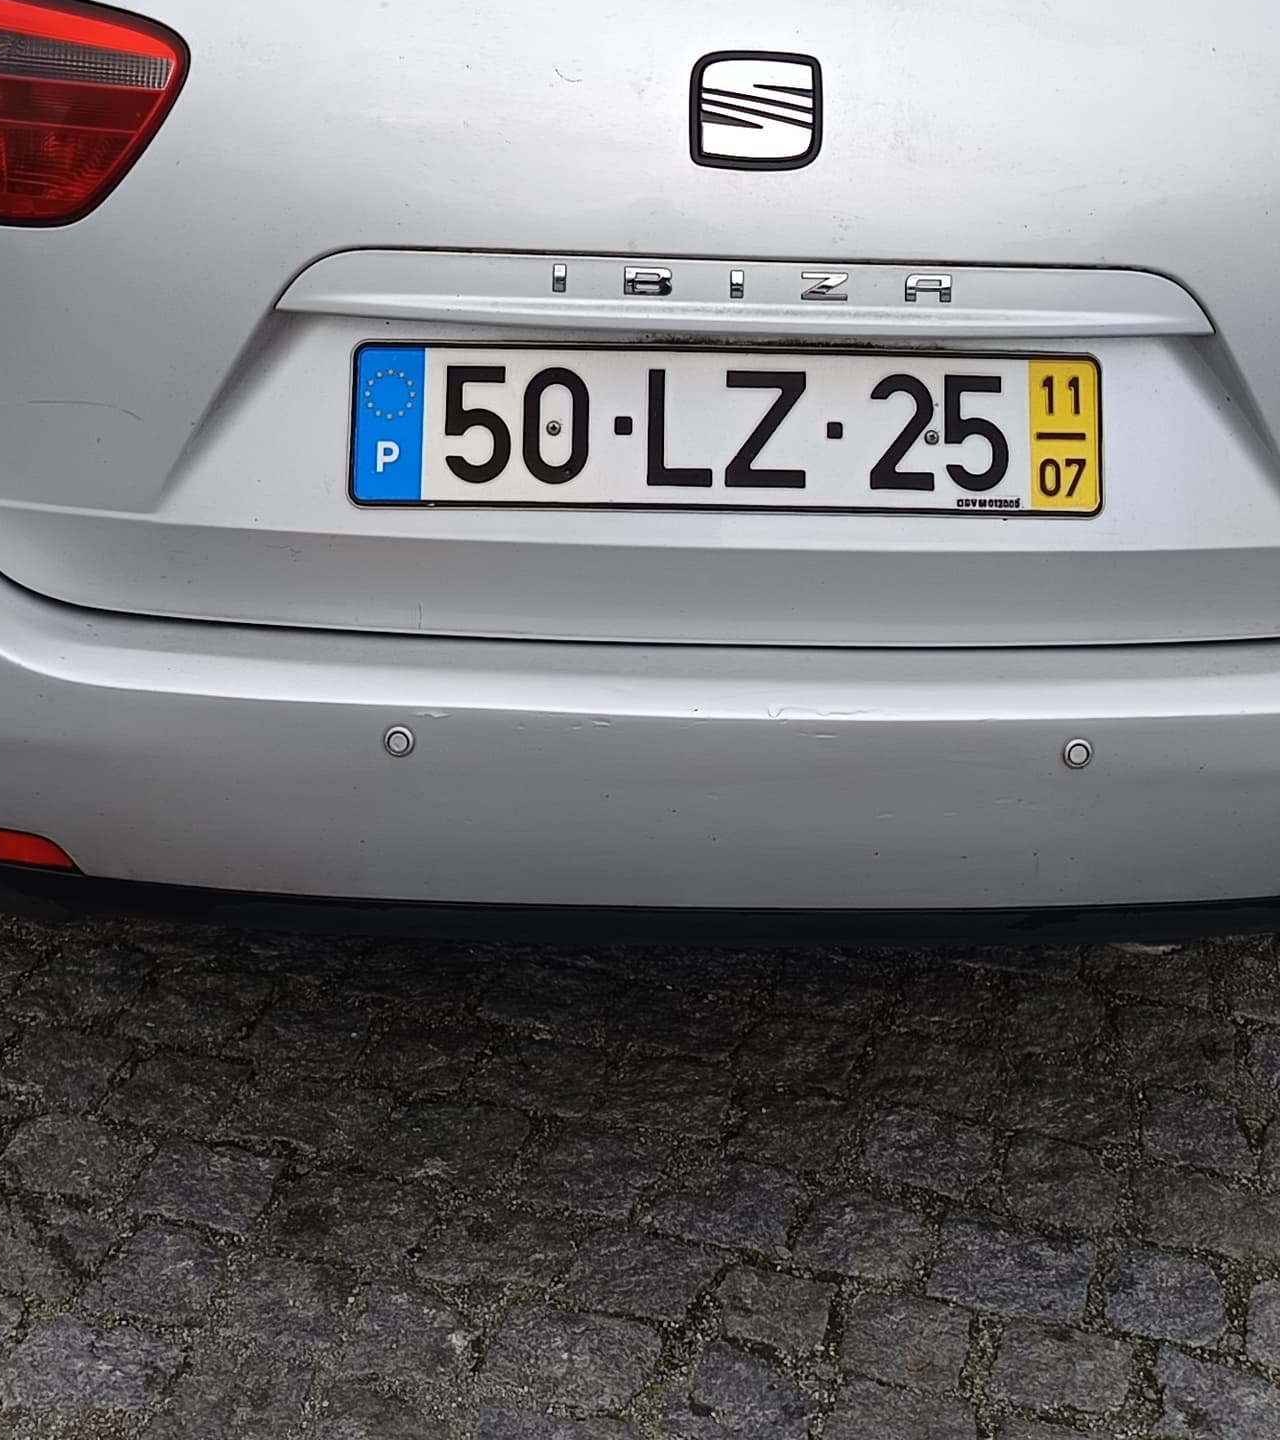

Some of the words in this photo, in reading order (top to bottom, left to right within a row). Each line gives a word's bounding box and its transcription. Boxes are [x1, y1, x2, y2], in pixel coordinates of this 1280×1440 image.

[552, 263, 953, 303] IBIZA
[1041, 375, 1081, 415] 11
[375, 440, 401, 474] P
[1038, 457, 1088, 498] 07
